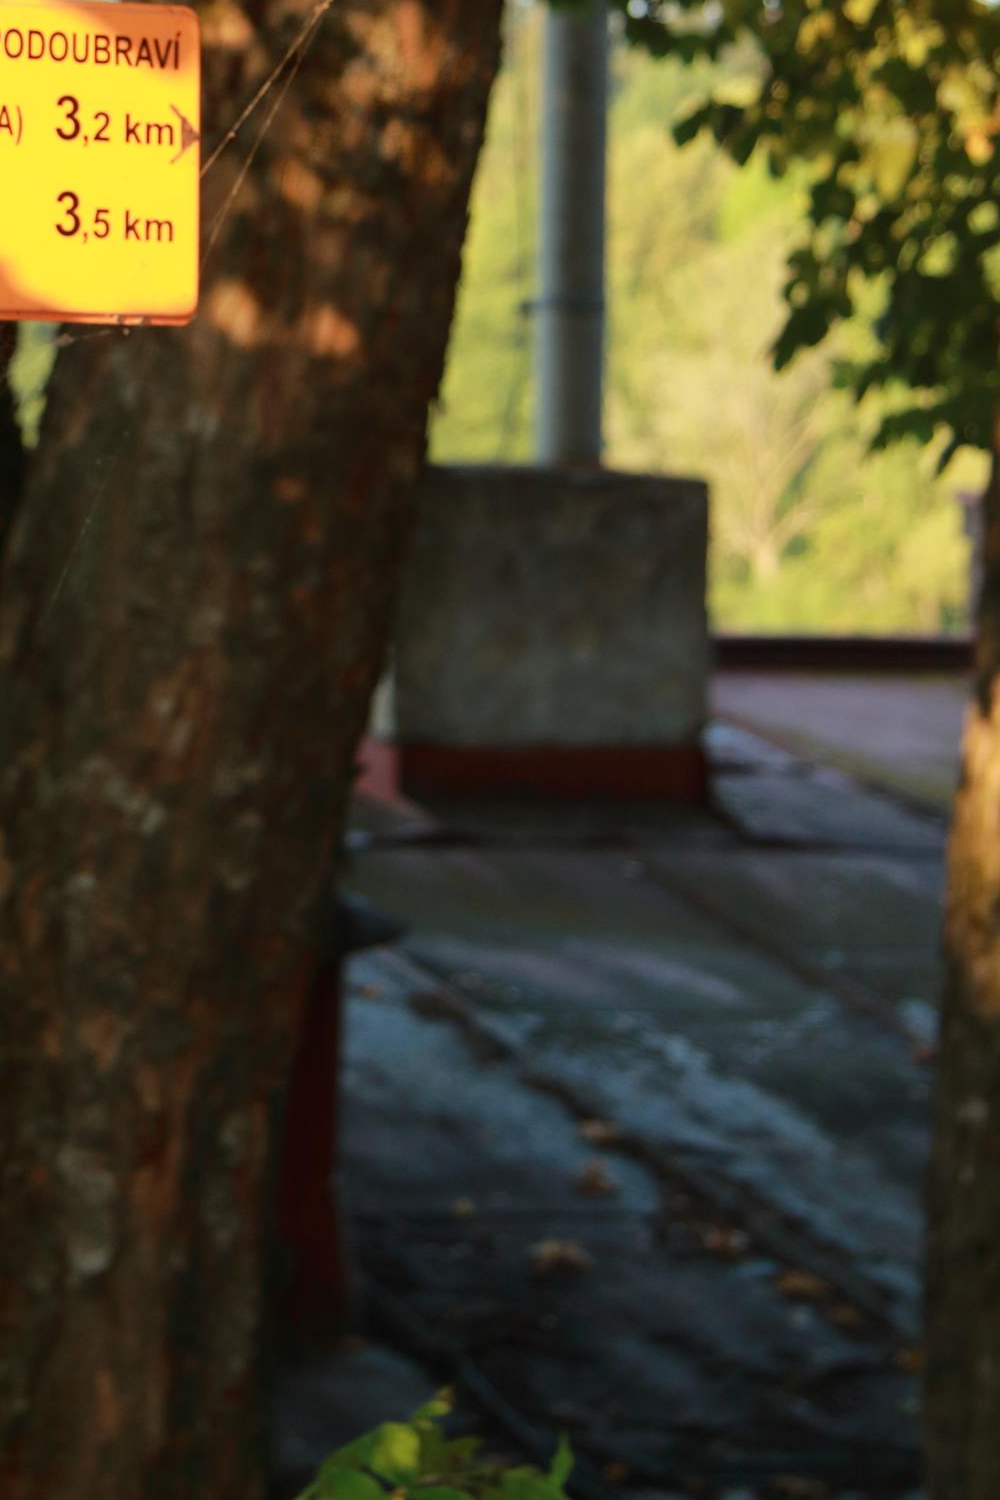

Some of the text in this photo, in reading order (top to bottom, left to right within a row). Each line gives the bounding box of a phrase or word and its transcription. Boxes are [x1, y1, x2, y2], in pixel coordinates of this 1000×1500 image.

[54, 96, 111, 146] 3,2
[124, 113, 175, 147] km
[54, 191, 111, 243] 3,5
[123, 208, 175, 243] km
